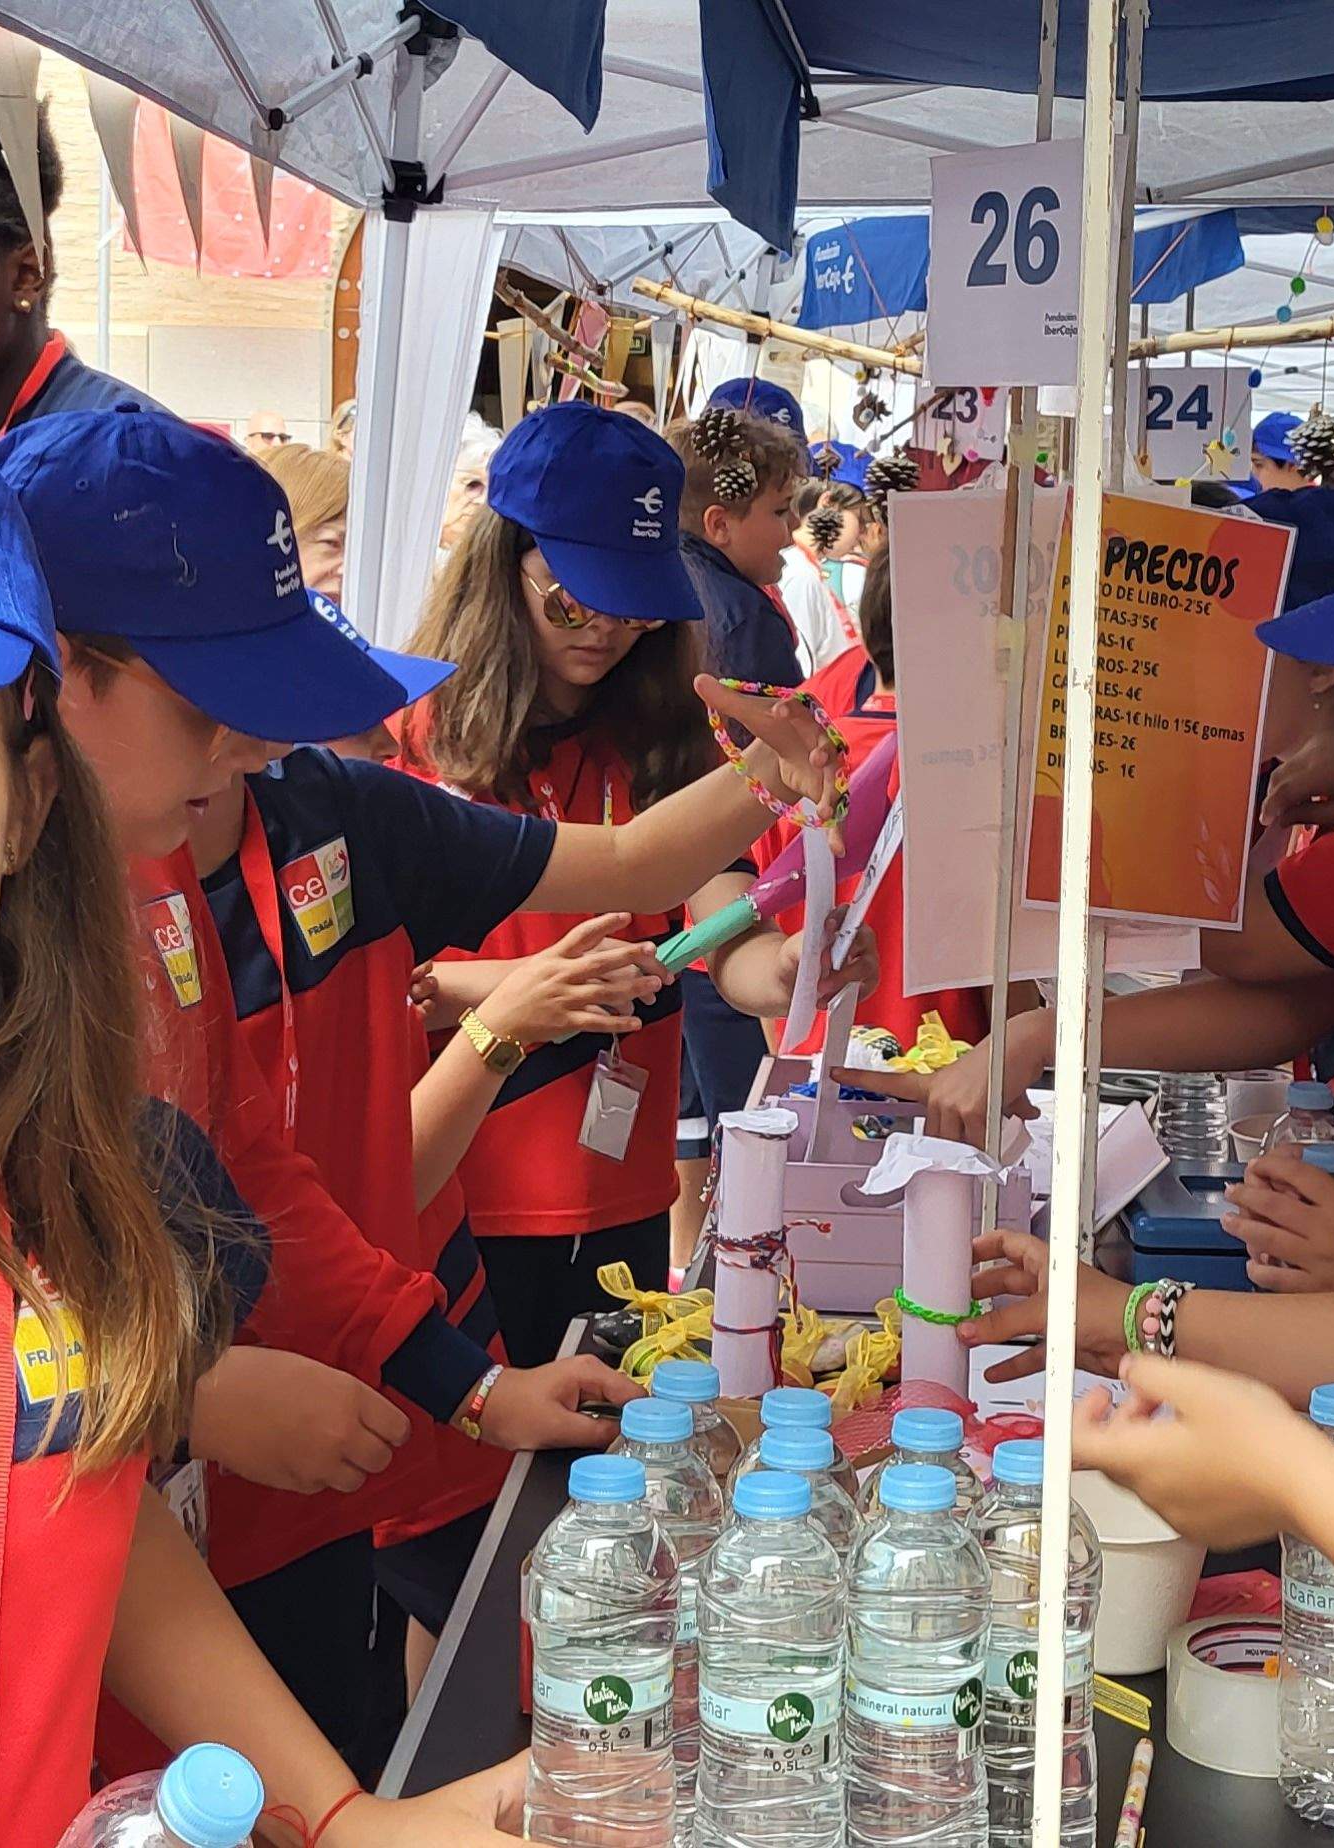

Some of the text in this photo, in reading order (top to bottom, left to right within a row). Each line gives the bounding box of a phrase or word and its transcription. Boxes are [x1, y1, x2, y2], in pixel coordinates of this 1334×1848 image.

[967, 186, 1061, 287] 26
[932, 386, 978, 423] 23
[1146, 384, 1213, 430] 24
[1104, 537, 1239, 598] PRECIOS
[1116, 584, 1133, 600] DE
[1125, 685, 1142, 701] 4€
[1144, 714, 1169, 730] hilo
[1202, 724, 1245, 742] gomas
[1121, 735, 1136, 751] 2€
[1120, 763, 1136, 779] 1€
[289, 876, 326, 906] ce
[308, 918, 333, 937] FRAGA
[858, 1696, 948, 1717] mineral natural
